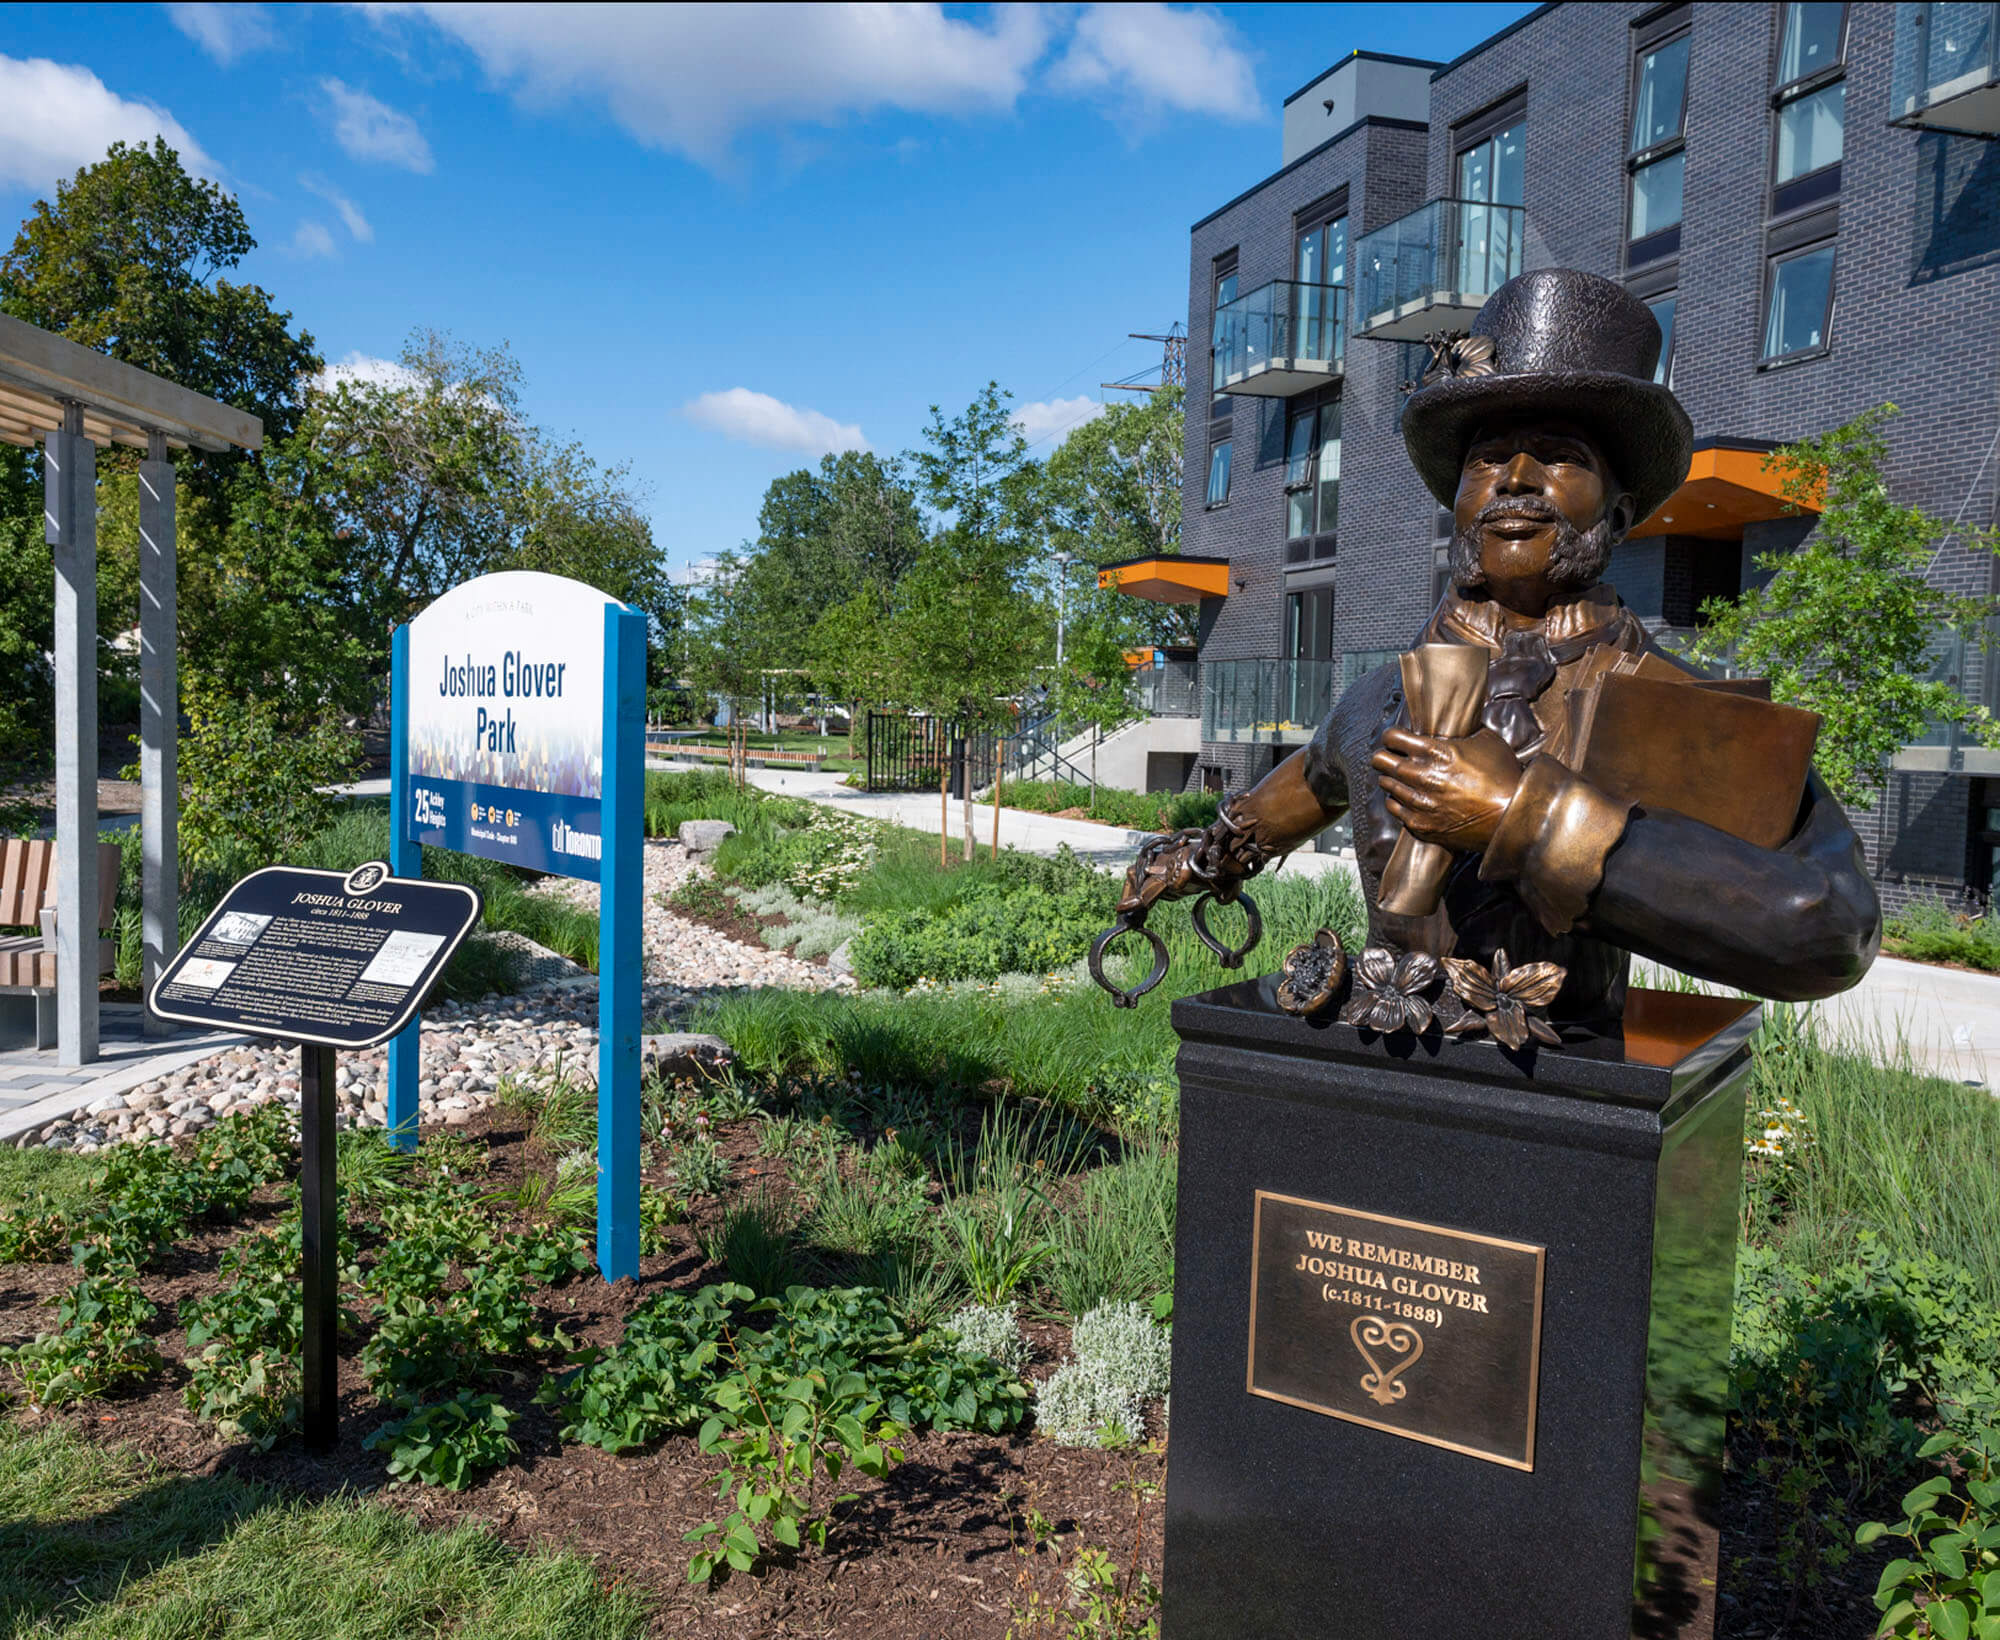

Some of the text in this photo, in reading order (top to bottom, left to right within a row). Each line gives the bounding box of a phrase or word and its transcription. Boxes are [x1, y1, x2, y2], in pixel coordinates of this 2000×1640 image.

[439, 650, 566, 698] Joshua Glover
[476, 706, 516, 753] Park
[416, 788, 430, 825] 25
[290, 892, 403, 914] JOSHUA GLOVER
[1304, 1230, 1481, 1285] WE REMEMBER
[1295, 1254, 1489, 1314] JOSHUA GLOVER
[1322, 1283, 1443, 1328] (c.1811-1888)
